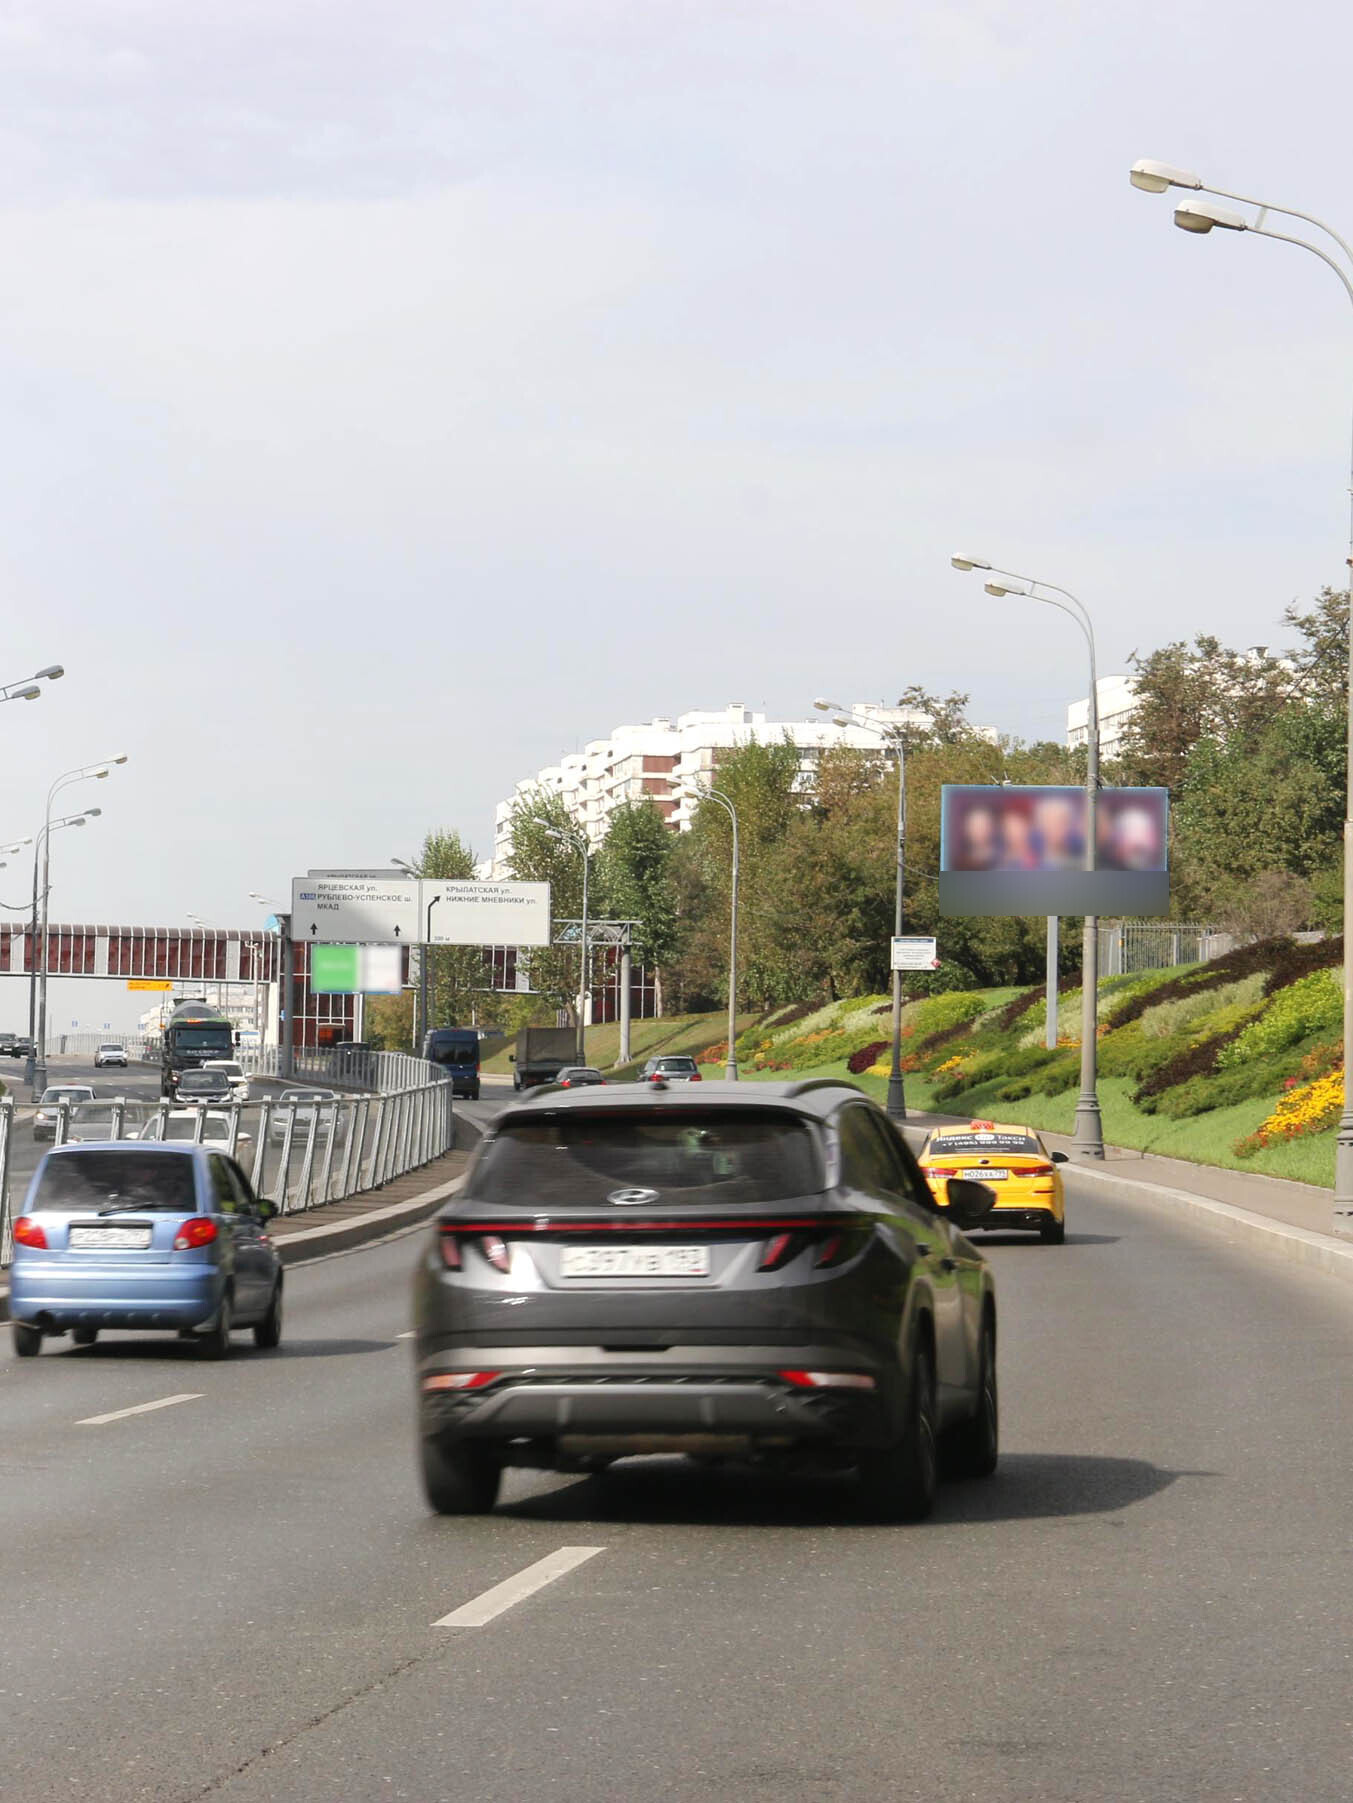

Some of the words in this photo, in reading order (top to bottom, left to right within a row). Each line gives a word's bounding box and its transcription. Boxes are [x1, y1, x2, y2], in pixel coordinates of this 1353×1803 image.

[317, 884, 365, 892] ЯРЦЕВСКАЯ
[446, 886, 499, 894] КРЫЛАТСКАЯ
[481, 896, 524, 904] МНЕВНИКИ
[317, 903, 340, 911] МКАД
